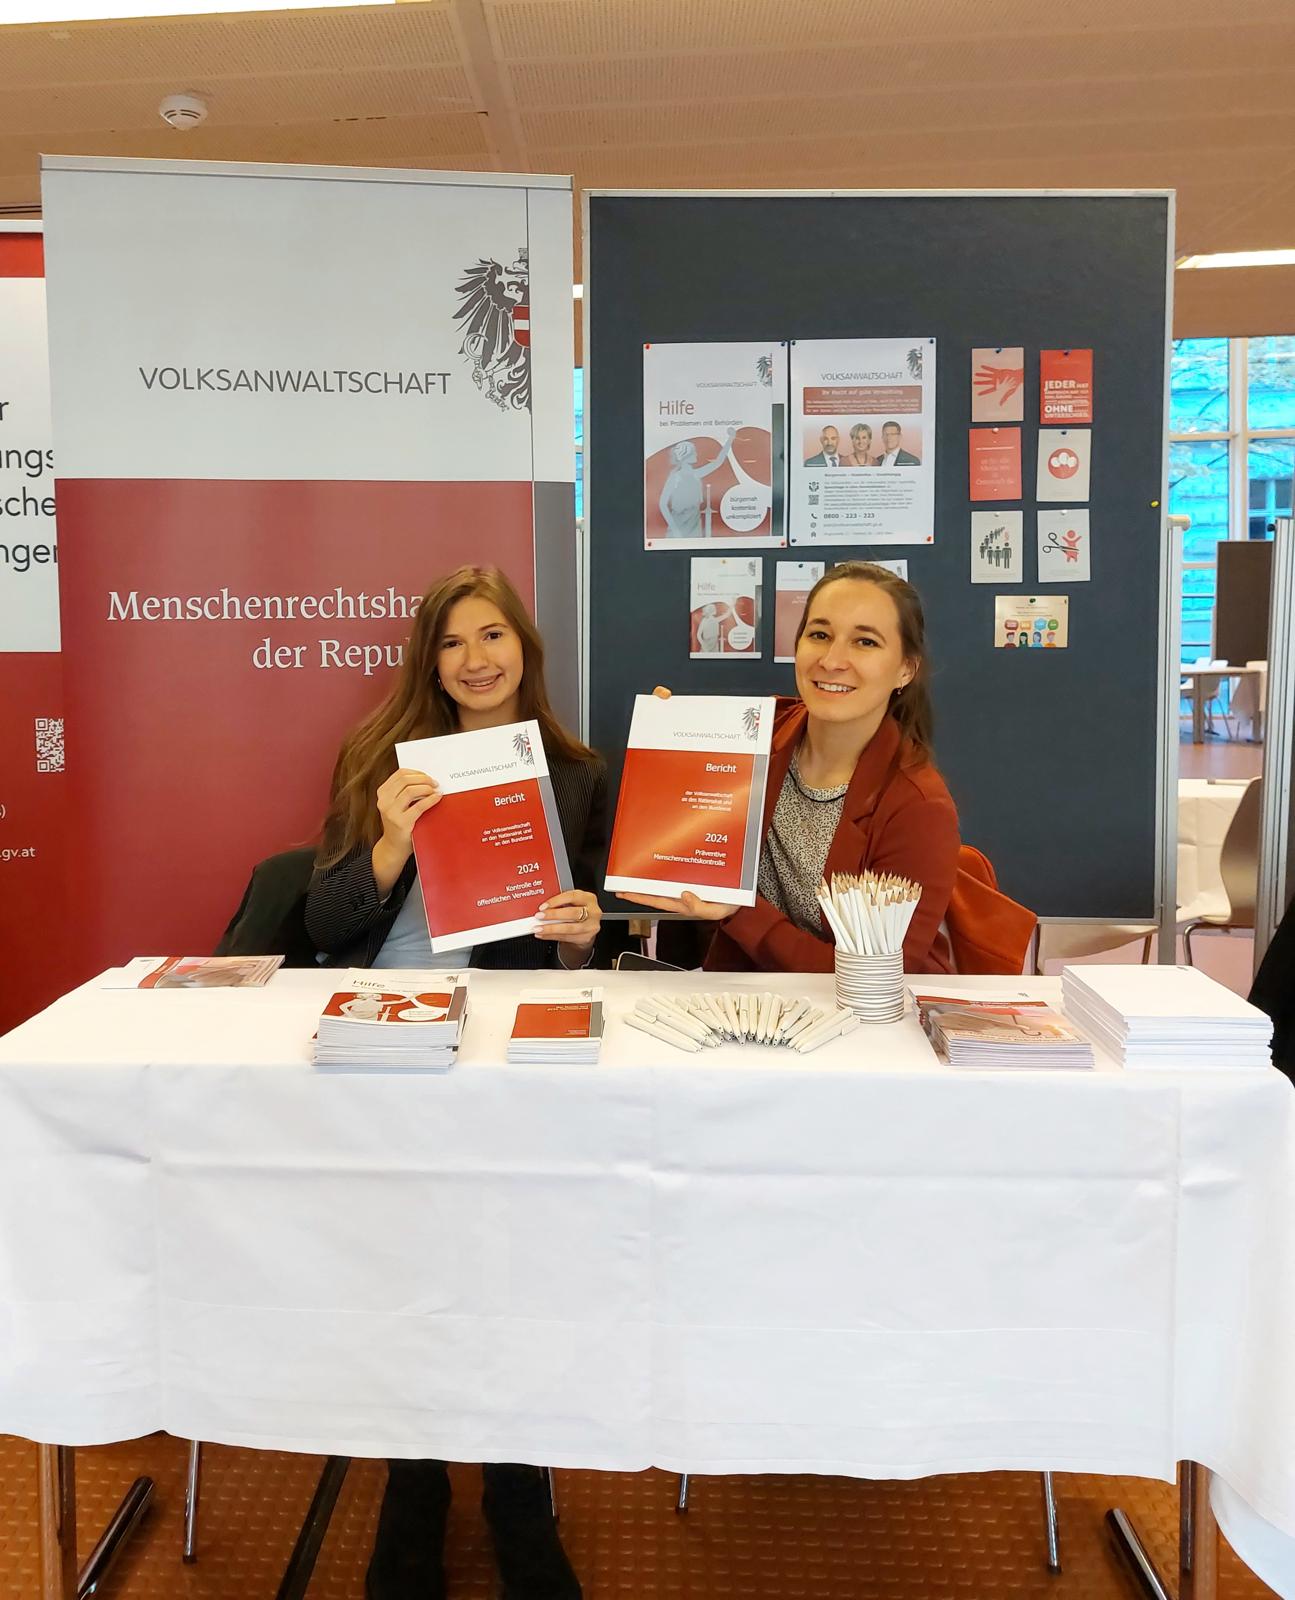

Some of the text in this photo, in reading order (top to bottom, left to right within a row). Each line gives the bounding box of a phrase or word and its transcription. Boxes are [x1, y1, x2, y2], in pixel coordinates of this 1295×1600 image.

[139, 367, 451, 394] VOLKSANWALTSCHAFT
[820, 372, 903, 382] VOLKSANWALTSCHAFT
[1044, 379, 1076, 391] JEDER
[659, 400, 695, 416] Hilfe
[1044, 405, 1073, 413] OHNE
[252, 638, 410, 676] der Repu
[705, 763, 737, 774] Bericht
[494, 792, 526, 807] Bericht
[705, 832, 728, 844] 2024
[653, 853, 726, 867] Menschenrechtskontrolle
[695, 849, 727, 859] Präventive
[517, 862, 540, 875] 2024
[505, 879, 543, 892] Kontrolle der
[476, 887, 545, 907] öffentlichen Verwaltung
